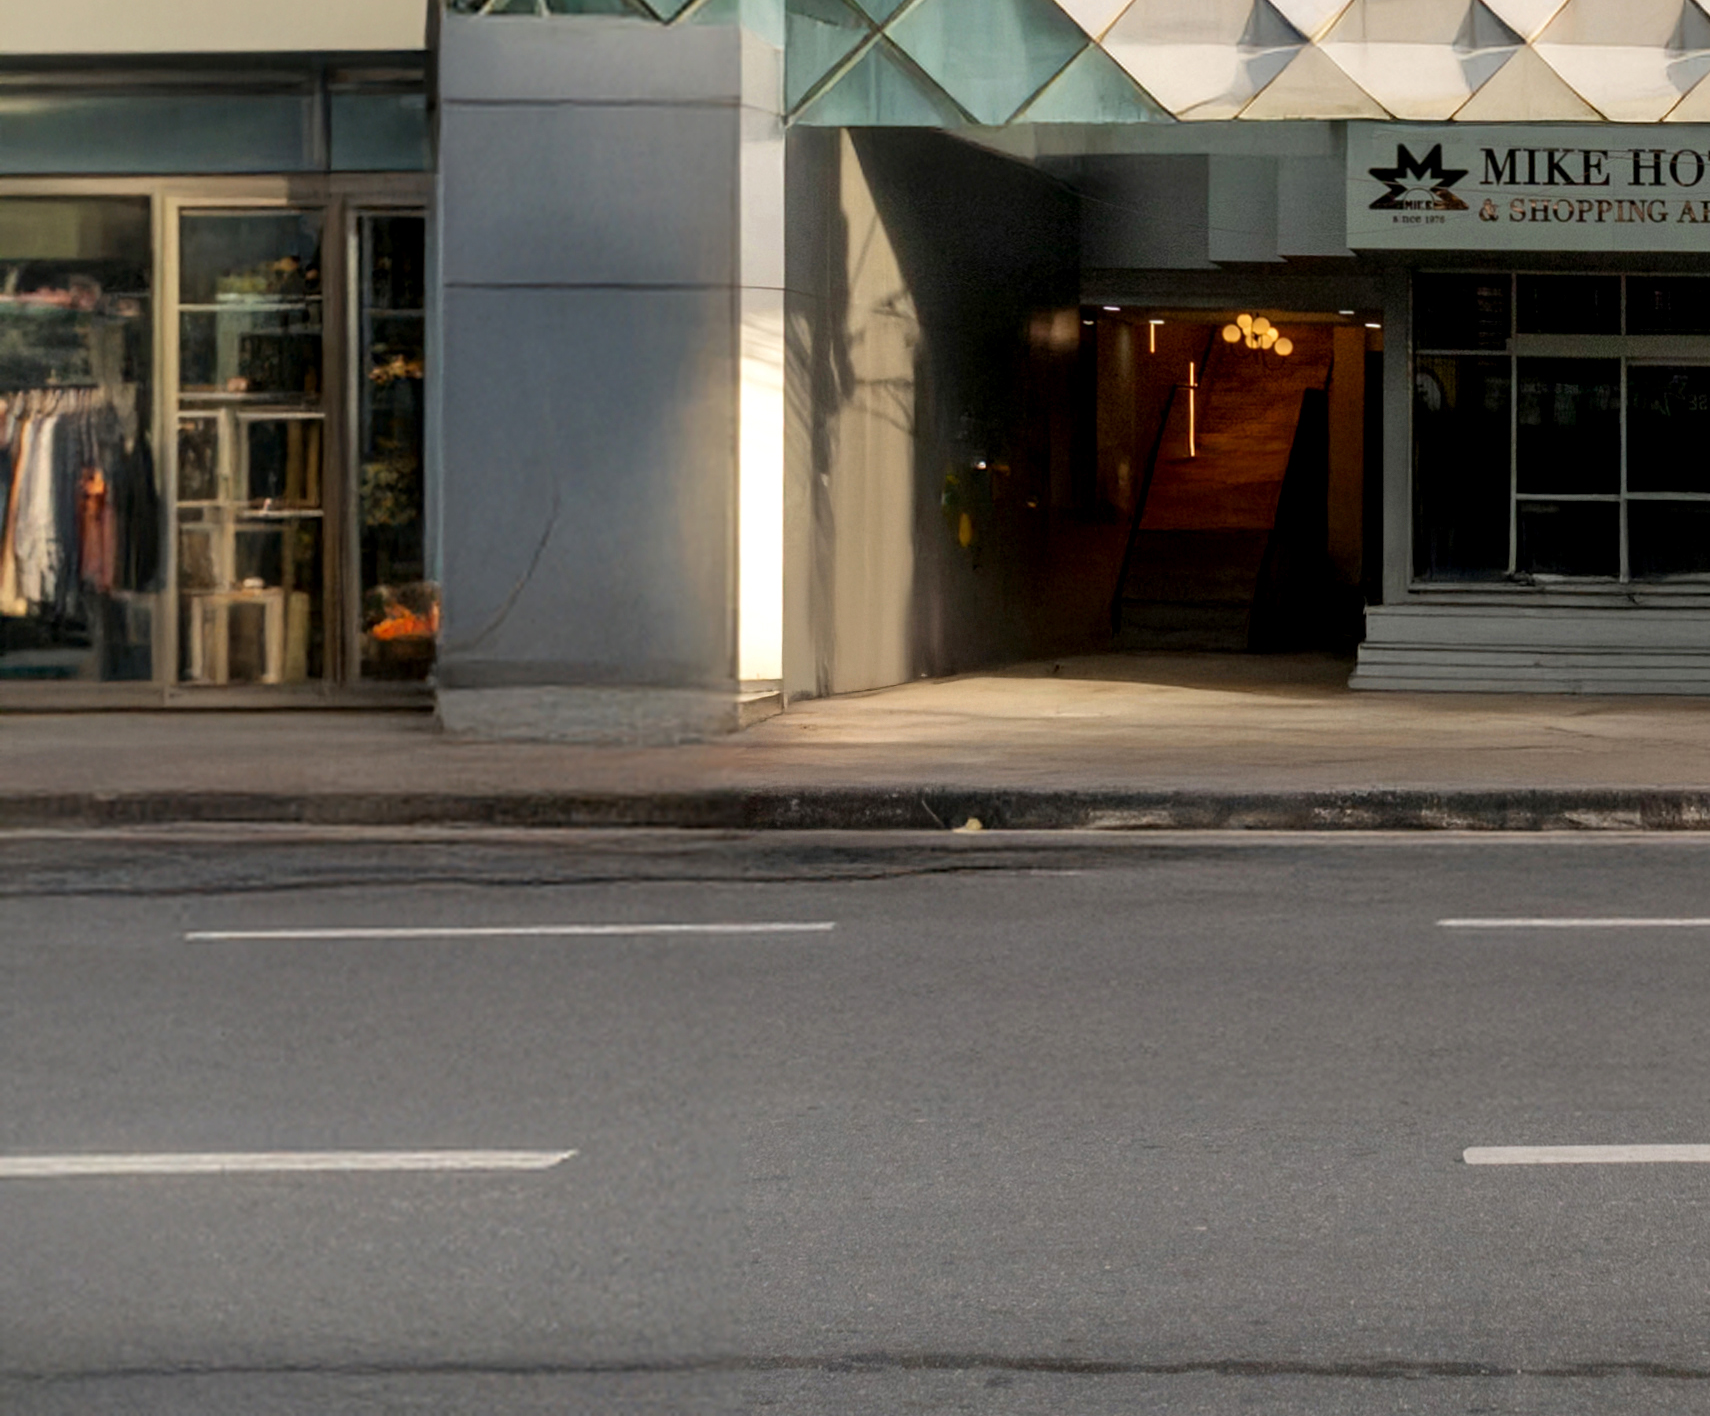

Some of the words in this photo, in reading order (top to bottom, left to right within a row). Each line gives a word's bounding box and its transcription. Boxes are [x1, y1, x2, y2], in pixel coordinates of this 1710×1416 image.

[1479, 148, 1611, 186] MIKE
[1479, 198, 1499, 223] &
[1509, 198, 1669, 224] SHOPPING
